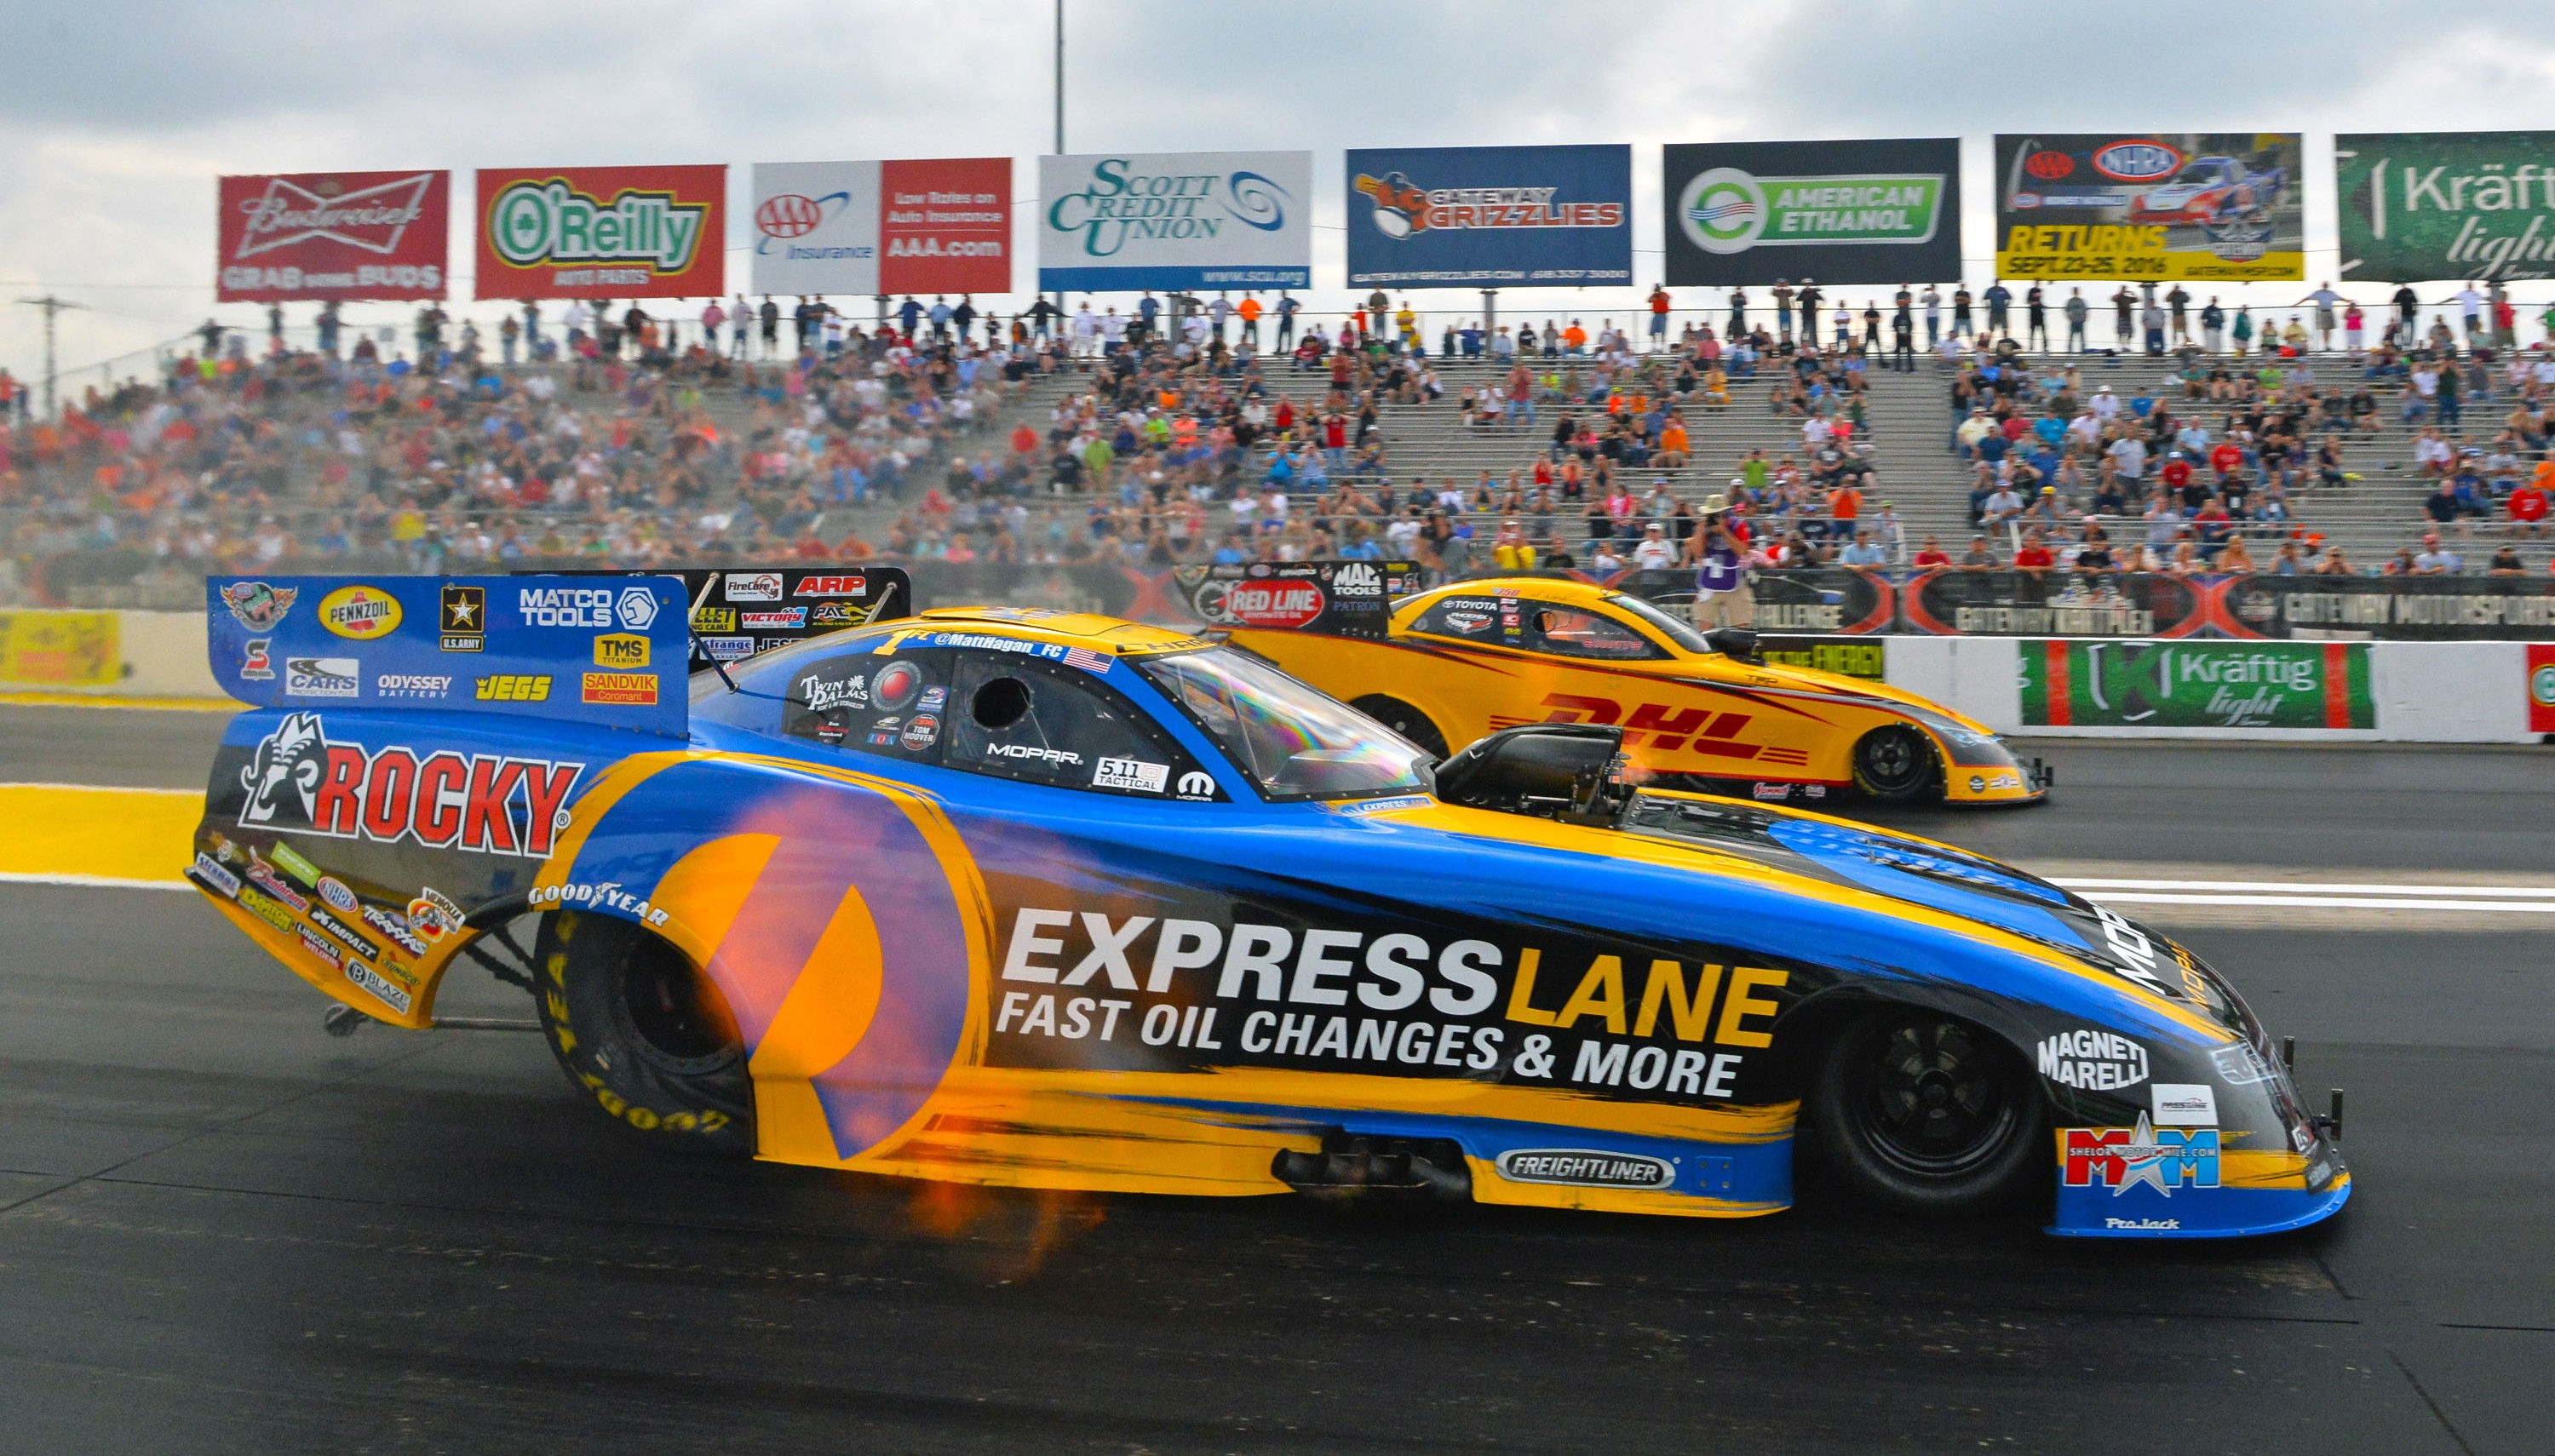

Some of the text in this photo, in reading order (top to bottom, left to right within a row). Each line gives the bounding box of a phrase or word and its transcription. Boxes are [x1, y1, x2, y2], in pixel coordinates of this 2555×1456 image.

[1089, 159, 1220, 197] SCOTT
[895, 191, 996, 204] Low Rates on
[1432, 189, 1550, 204] GATEWAY
[1774, 186, 1924, 209] AMERICAN
[760, 196, 818, 235] AAA
[887, 210, 1004, 223] Auto Insurance
[1049, 193, 1204, 232] CREDIT
[1429, 204, 1622, 227] GRIZZLIES
[1779, 210, 1914, 232] ETHANOL
[497, 187, 695, 264] O'Reilly
[887, 238, 1003, 257] AAA.com
[1084, 218, 1223, 256] UNION
[2007, 226, 2169, 252] RETURNS
[786, 245, 873, 260] Insurance
[222, 266, 304, 290] GRAB
[356, 265, 443, 289] BUDS
[797, 576, 865, 593] ARP
[1333, 563, 1381, 587] MAC
[520, 588, 612, 608] MATCO
[727, 582, 771, 592] FireCore
[1334, 587, 1382, 595] TOOLS
[330, 600, 391, 622] PENNZOIL
[1232, 590, 1316, 610] RED LINE
[1454, 599, 1497, 610] TOYOTA
[520, 607, 612, 627] TOOLS
[742, 613, 803, 622] VICTORY
[812, 603, 852, 620] PAC
[601, 640, 643, 656] TMS
[703, 639, 752, 650] Strange
[934, 633, 1064, 658] @MattHagan_FC
[1812, 645, 1884, 675] ENERGY
[290, 675, 357, 690] CARS
[378, 675, 452, 691] ODYSSEY
[585, 674, 656, 690] SANDVIK
[2181, 653, 2317, 691] Kräftig
[379, 690, 448, 699] BATTERY
[475, 675, 553, 701] JEGS
[598, 691, 642, 702] Coromant
[800, 674, 844, 699] TWIN
[807, 689, 870, 711] PALMS
[2205, 685, 2284, 722] light
[904, 732, 934, 742] HOOVER
[913, 725, 931, 735] TOM
[1540, 693, 1764, 760] DHL
[986, 743, 1080, 765] MOPAR
[1100, 760, 1140, 779] 5.11
[1099, 776, 1157, 790] TACTICAL
[313, 744, 584, 856] ROCKY
[323, 882, 353, 908] NHRA
[296, 923, 340, 957] LINCOLN
[327, 921, 376, 957] IMPACT
[364, 904, 429, 955] TRAXXAS
[367, 972, 410, 1003] BLAZE
[995, 992, 1743, 1098] FAST OIL CHANGES & MORE
[2070, 1147, 2112, 1157] SHELOR
[1510, 1154, 1660, 1183] FREIGHTLINER
